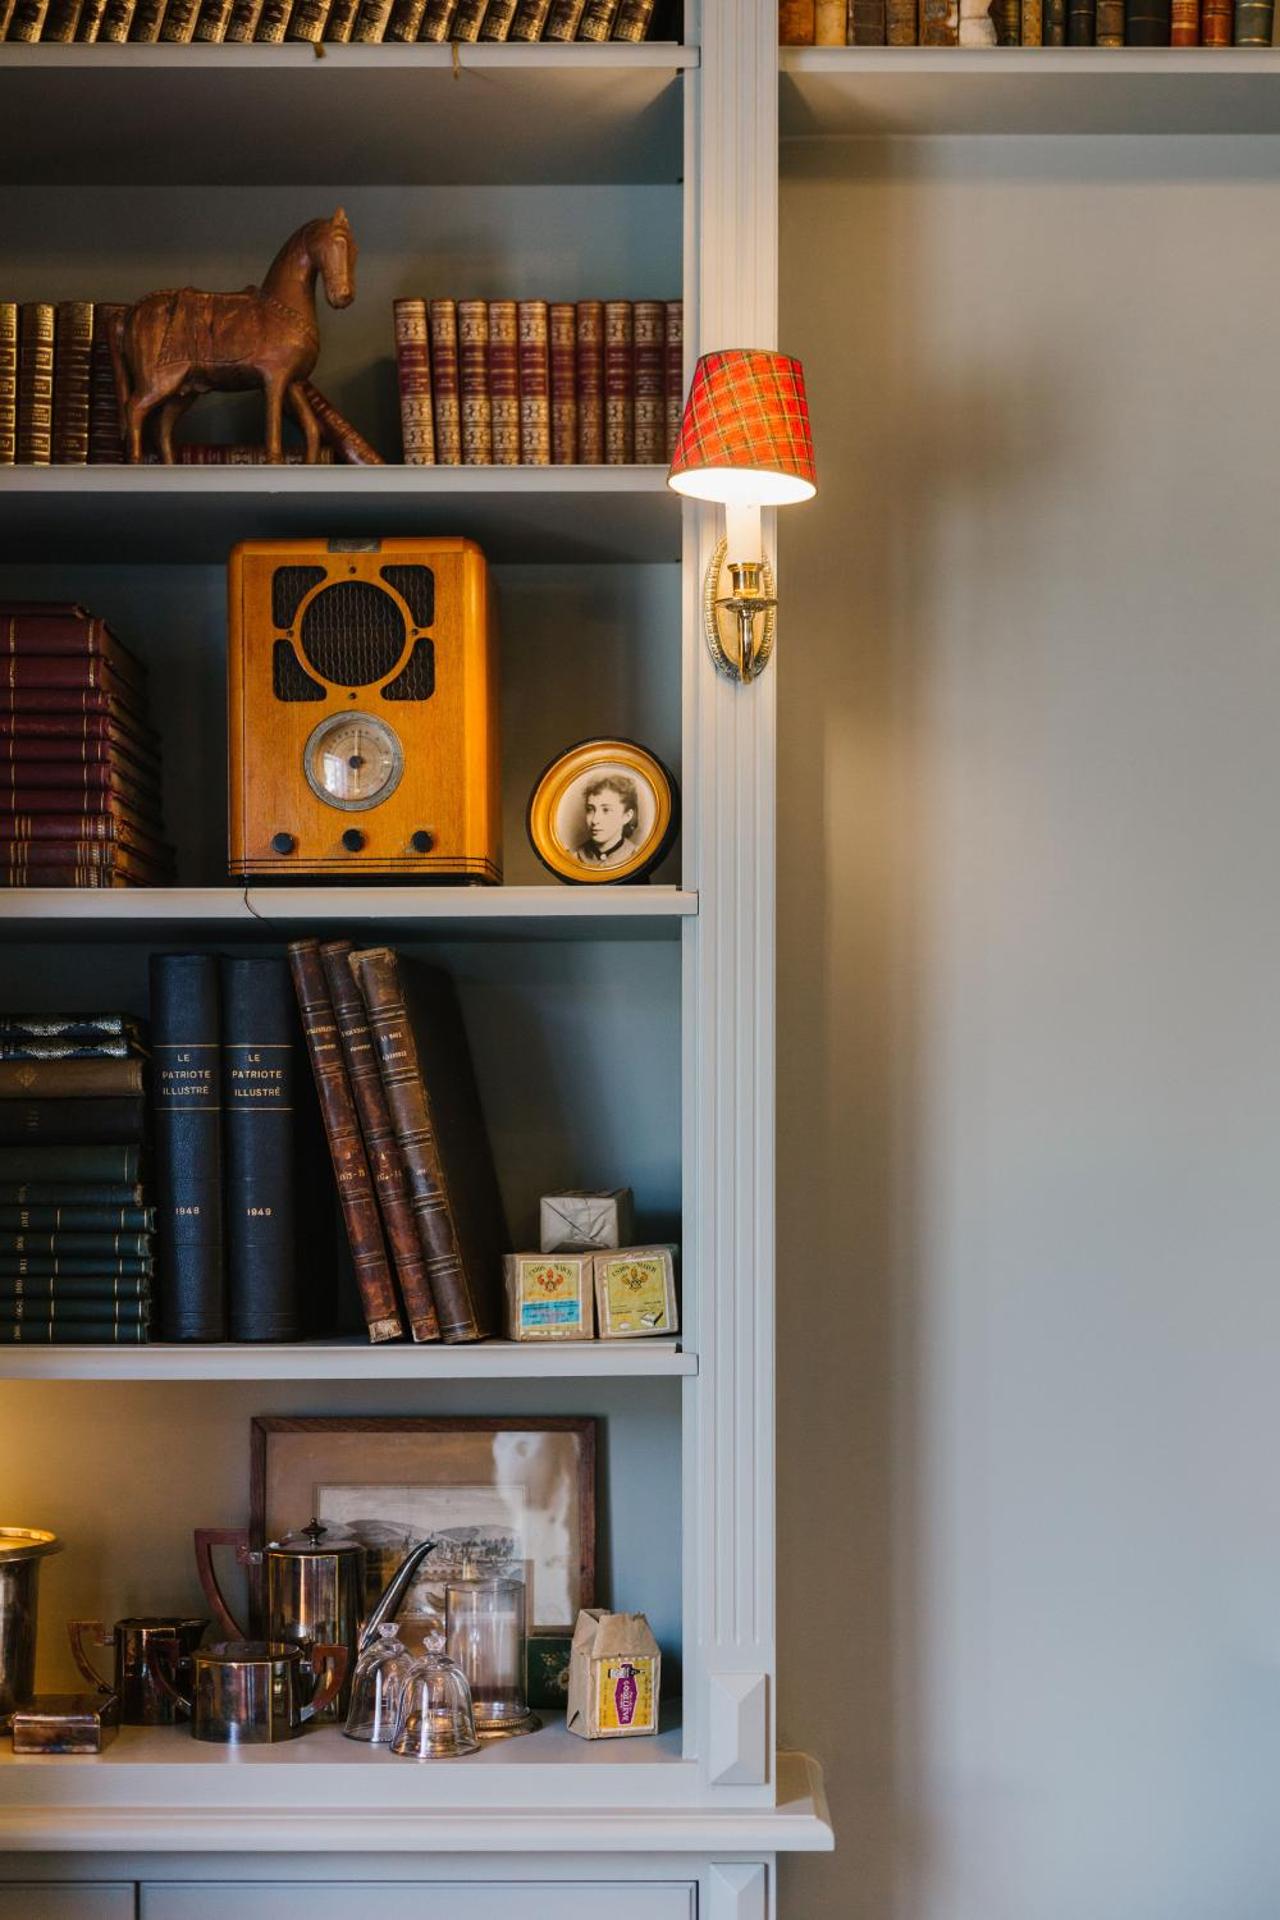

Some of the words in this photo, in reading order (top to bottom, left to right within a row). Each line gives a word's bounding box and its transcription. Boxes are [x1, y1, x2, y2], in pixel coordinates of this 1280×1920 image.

[177, 1053, 191, 1062] LE
[248, 1053, 261, 1062] LE
[162, 1070, 211, 1079] PATRIOTE
[232, 1070, 282, 1079] PATRIOTE
[163, 1085, 209, 1095] ILLUSTRÉ
[235, 1086, 281, 1097] ILLUSTRÉ
